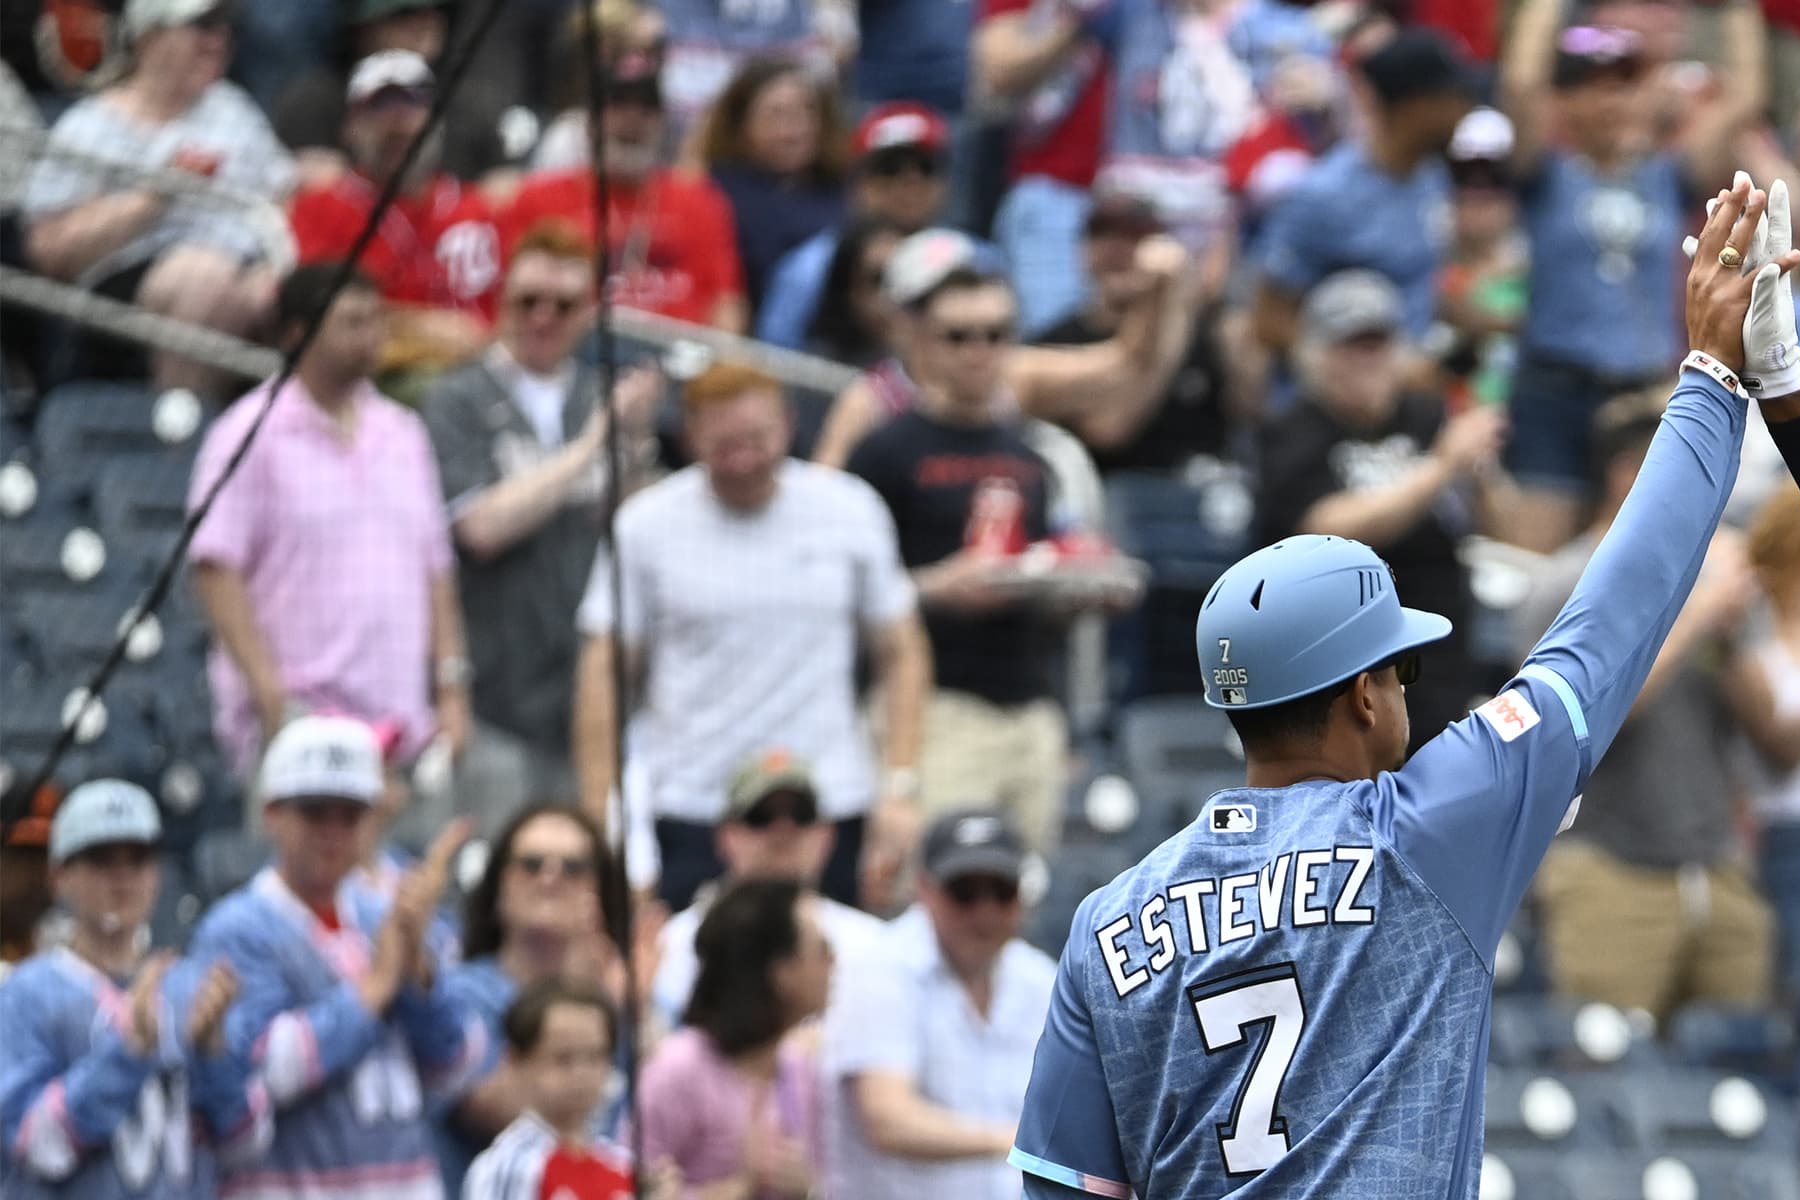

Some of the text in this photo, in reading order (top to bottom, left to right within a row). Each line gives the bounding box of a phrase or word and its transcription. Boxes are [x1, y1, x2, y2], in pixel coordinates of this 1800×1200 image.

[1212, 667, 1249, 686] 2005
[1218, 638, 1230, 663] 7
[1094, 845, 1375, 1000] ESTEVEZ
[1185, 961, 1308, 1178] 7
